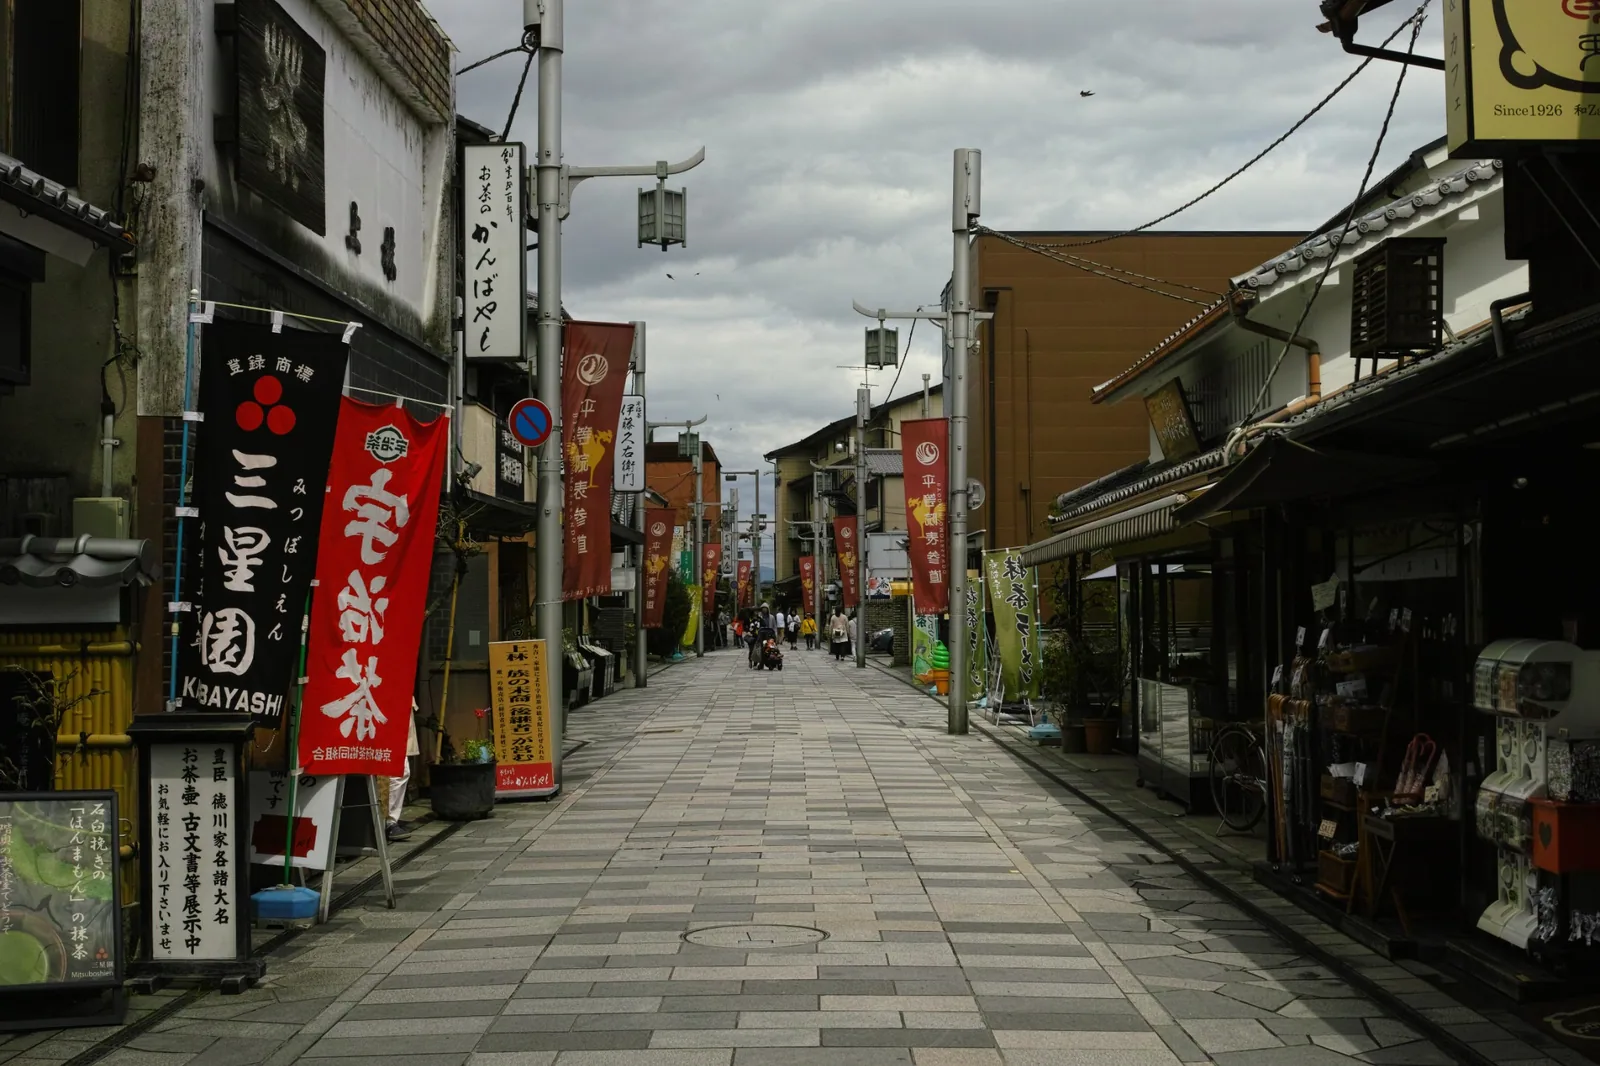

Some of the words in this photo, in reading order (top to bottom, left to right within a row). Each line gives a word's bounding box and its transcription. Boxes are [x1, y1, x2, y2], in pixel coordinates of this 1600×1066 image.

[1494, 104, 1563, 117] Since1926
[620, 403, 635, 487] 伊藤久右衛門
[202, 449, 278, 676] 三星園
[268, 476, 308, 641] みつぼしえん
[90, 803, 108, 881] 石臼挽きの
[71, 970, 114, 979] Mitsuboshien
